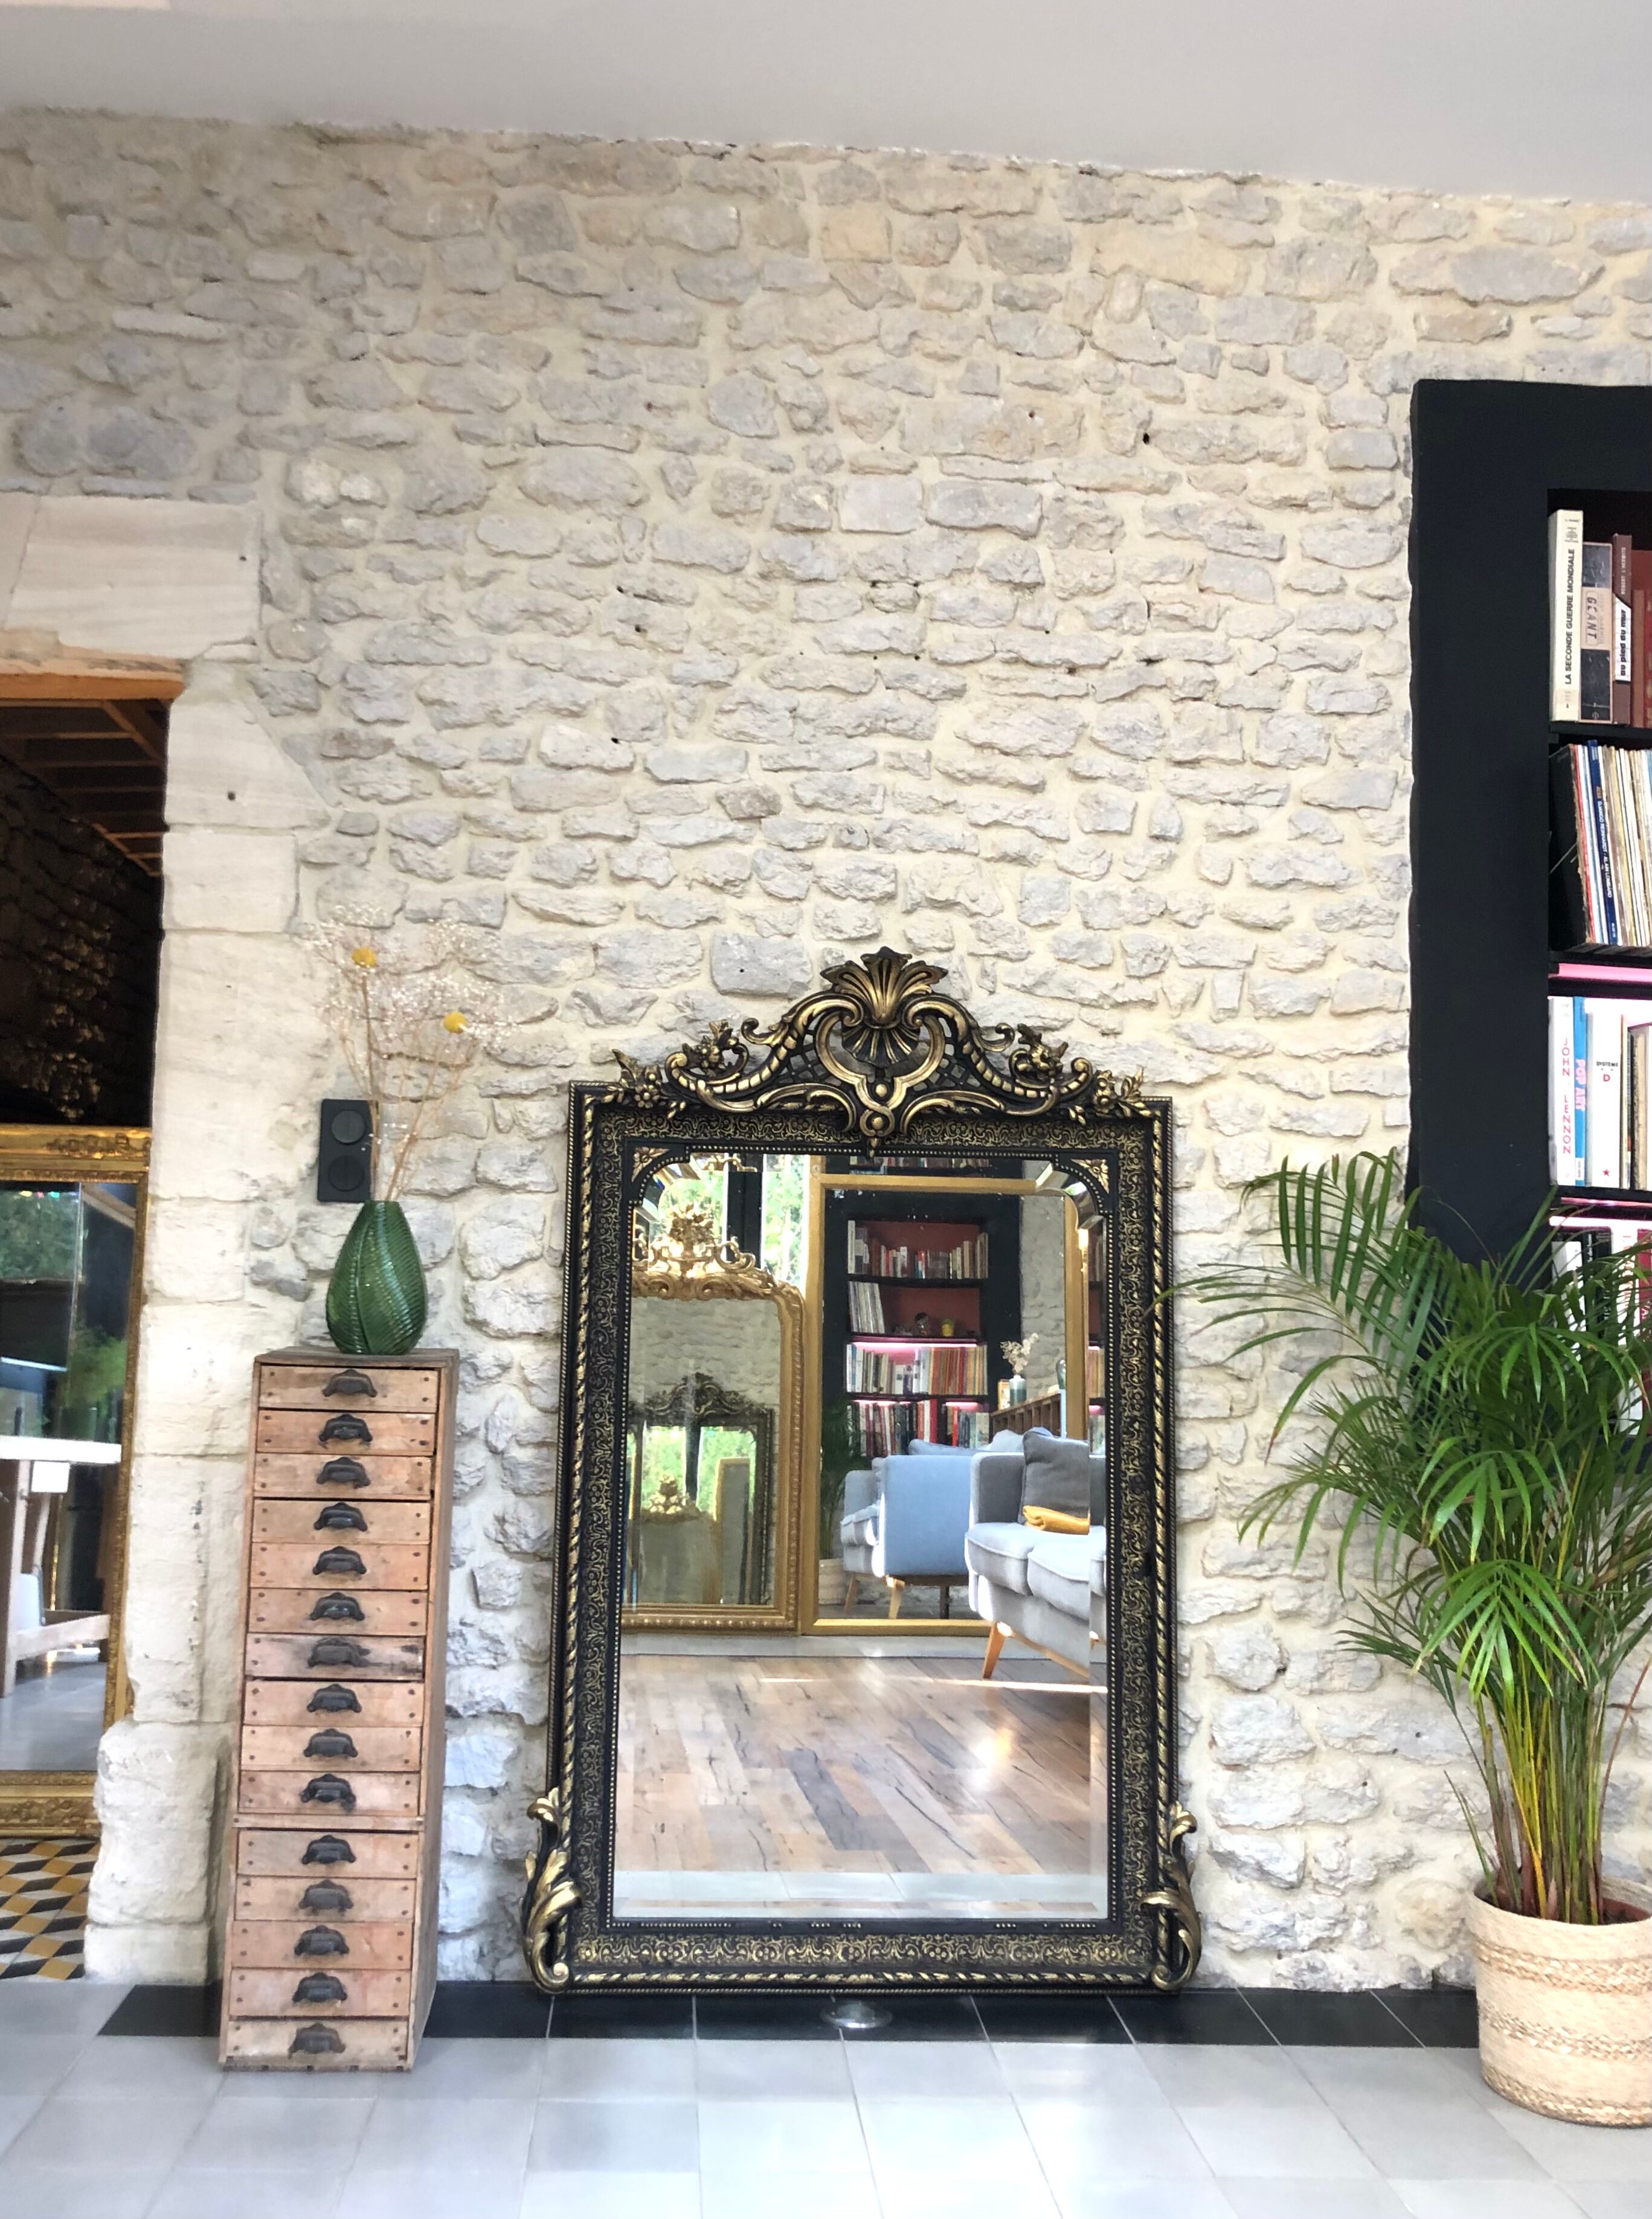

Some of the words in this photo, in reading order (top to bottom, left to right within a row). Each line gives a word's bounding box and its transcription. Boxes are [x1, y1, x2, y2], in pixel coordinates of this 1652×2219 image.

[1621, 629, 1626, 641] du
[1565, 674, 1572, 685] LA
[1621, 664, 1626, 676] au
[1561, 1038, 1570, 1076] JOHN
[1575, 1059, 1586, 1085] POP
[1575, 1087, 1586, 1111] ART
[1563, 1094, 1571, 1154] LENNON
